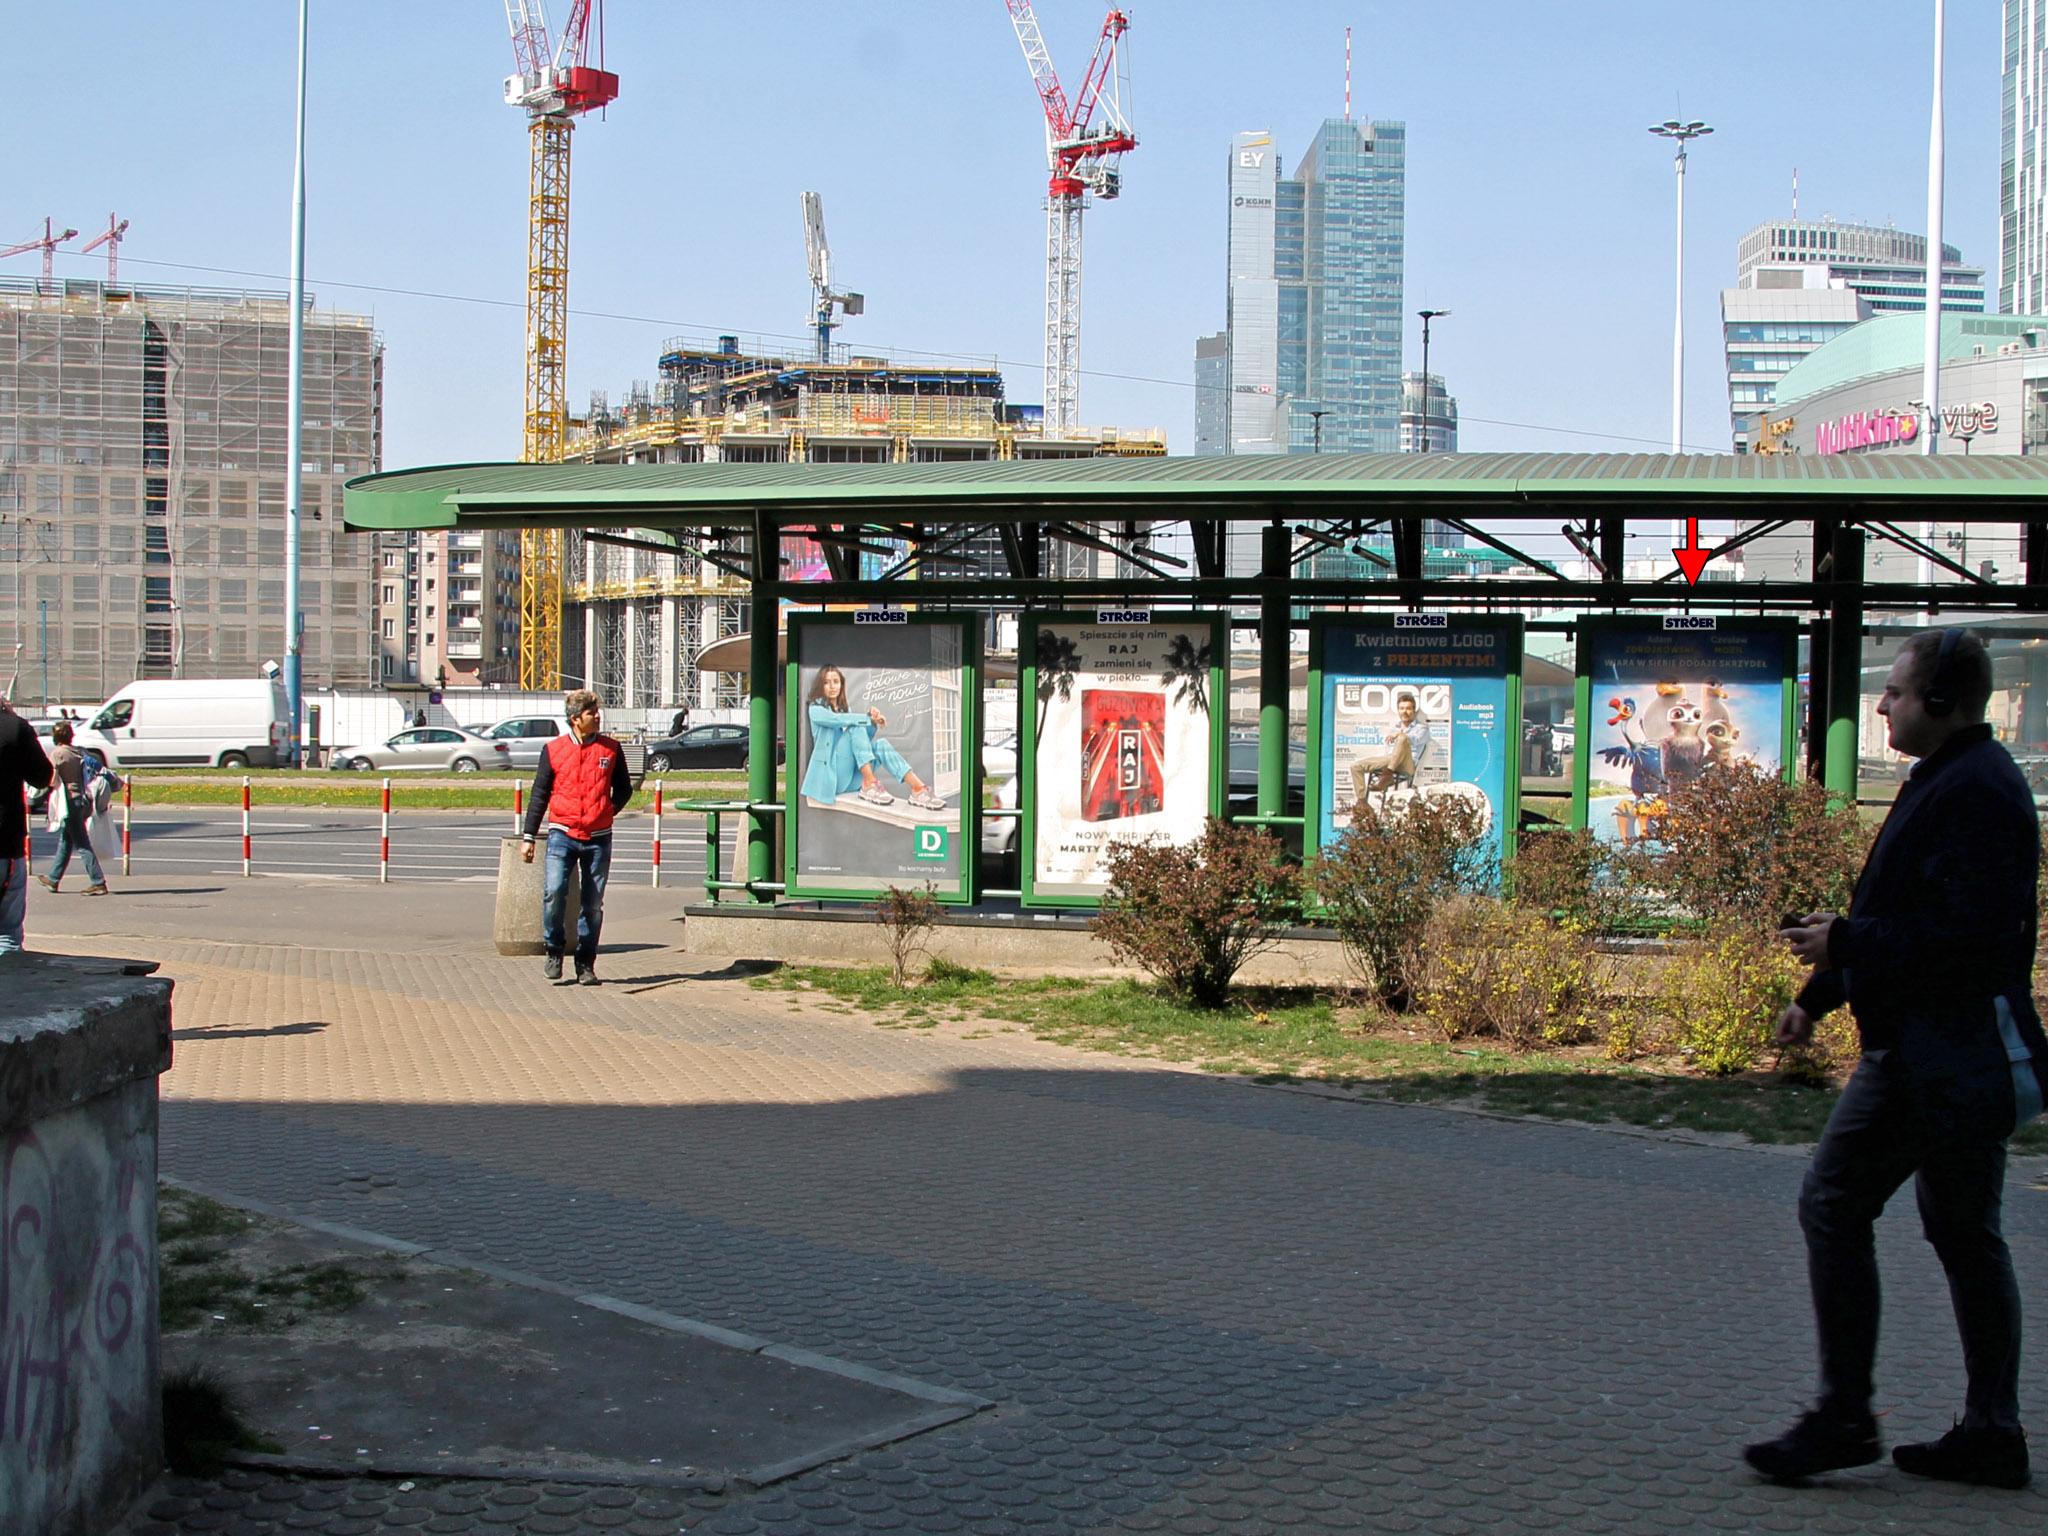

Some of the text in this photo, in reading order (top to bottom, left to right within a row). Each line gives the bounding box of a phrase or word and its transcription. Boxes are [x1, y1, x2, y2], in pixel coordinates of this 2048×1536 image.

[1240, 151, 1265, 168] EY
[1245, 197, 1272, 205] KGHM
[1815, 408, 1918, 456] Multikino
[856, 611, 906, 622] STRÖER
[1099, 611, 1149, 622] STRÖER
[1396, 615, 1446, 626] STRÖER
[1665, 617, 1715, 628] STRÖER
[1079, 629, 1168, 641] Spieszcie się nim
[1354, 633, 1495, 648] Kwietniowe LOGO
[1108, 644, 1139, 655] RAJ
[1094, 659, 1153, 669] zamieni się
[1373, 653, 1496, 667] z PREZENTEM!
[1096, 674, 1106, 682] w
[1336, 684, 1450, 715] LOGO
[1458, 703, 1494, 711] Audiobook
[1122, 735, 1137, 784] RAJ
[921, 830, 942, 852] D
[1075, 831, 1111, 841] NOWY
[1060, 844, 1101, 853] MARTY
